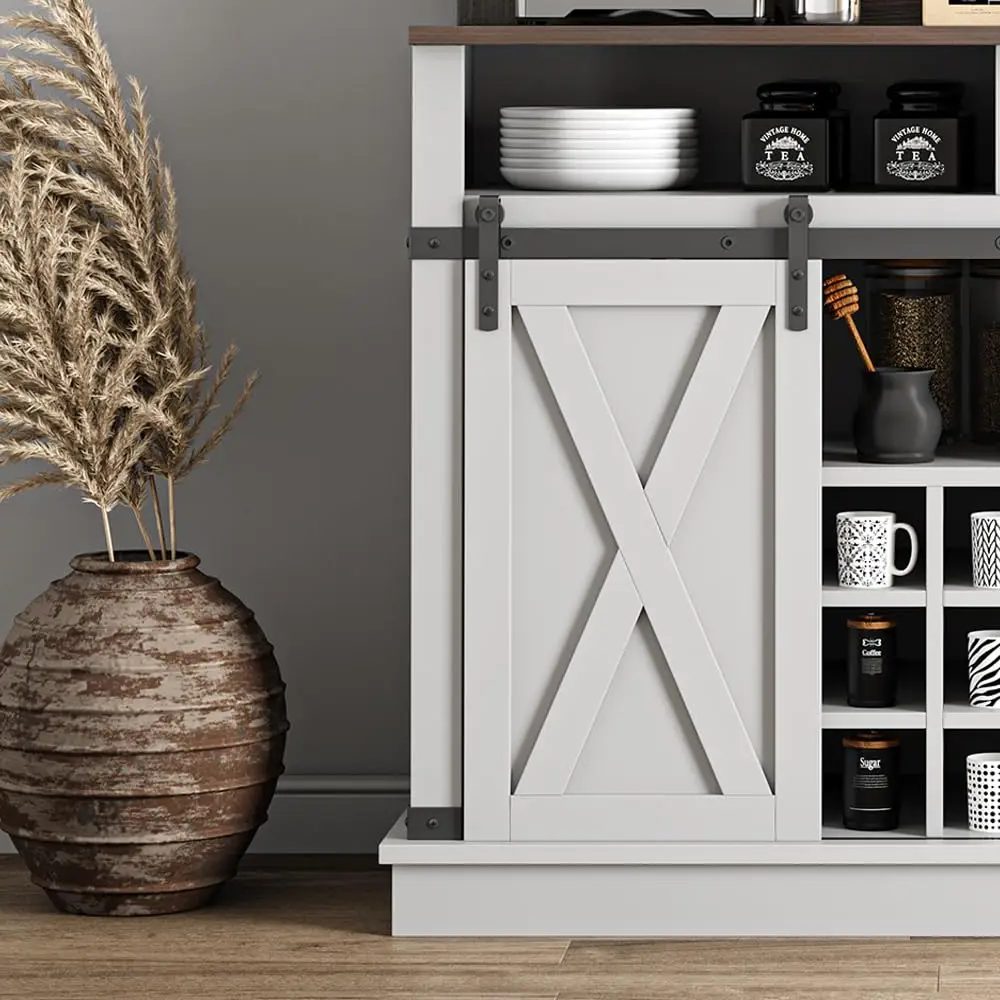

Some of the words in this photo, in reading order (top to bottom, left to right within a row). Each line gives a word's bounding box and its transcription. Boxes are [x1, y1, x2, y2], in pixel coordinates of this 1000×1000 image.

[760, 126, 789, 142] VINTAGE
[790, 127, 811, 144] HOME
[891, 126, 920, 142] VINTAGE
[921, 127, 942, 144] HOME
[764, 151, 805, 161] TEA
[895, 151, 936, 161] TEA
[860, 756, 881, 771] Sugar
